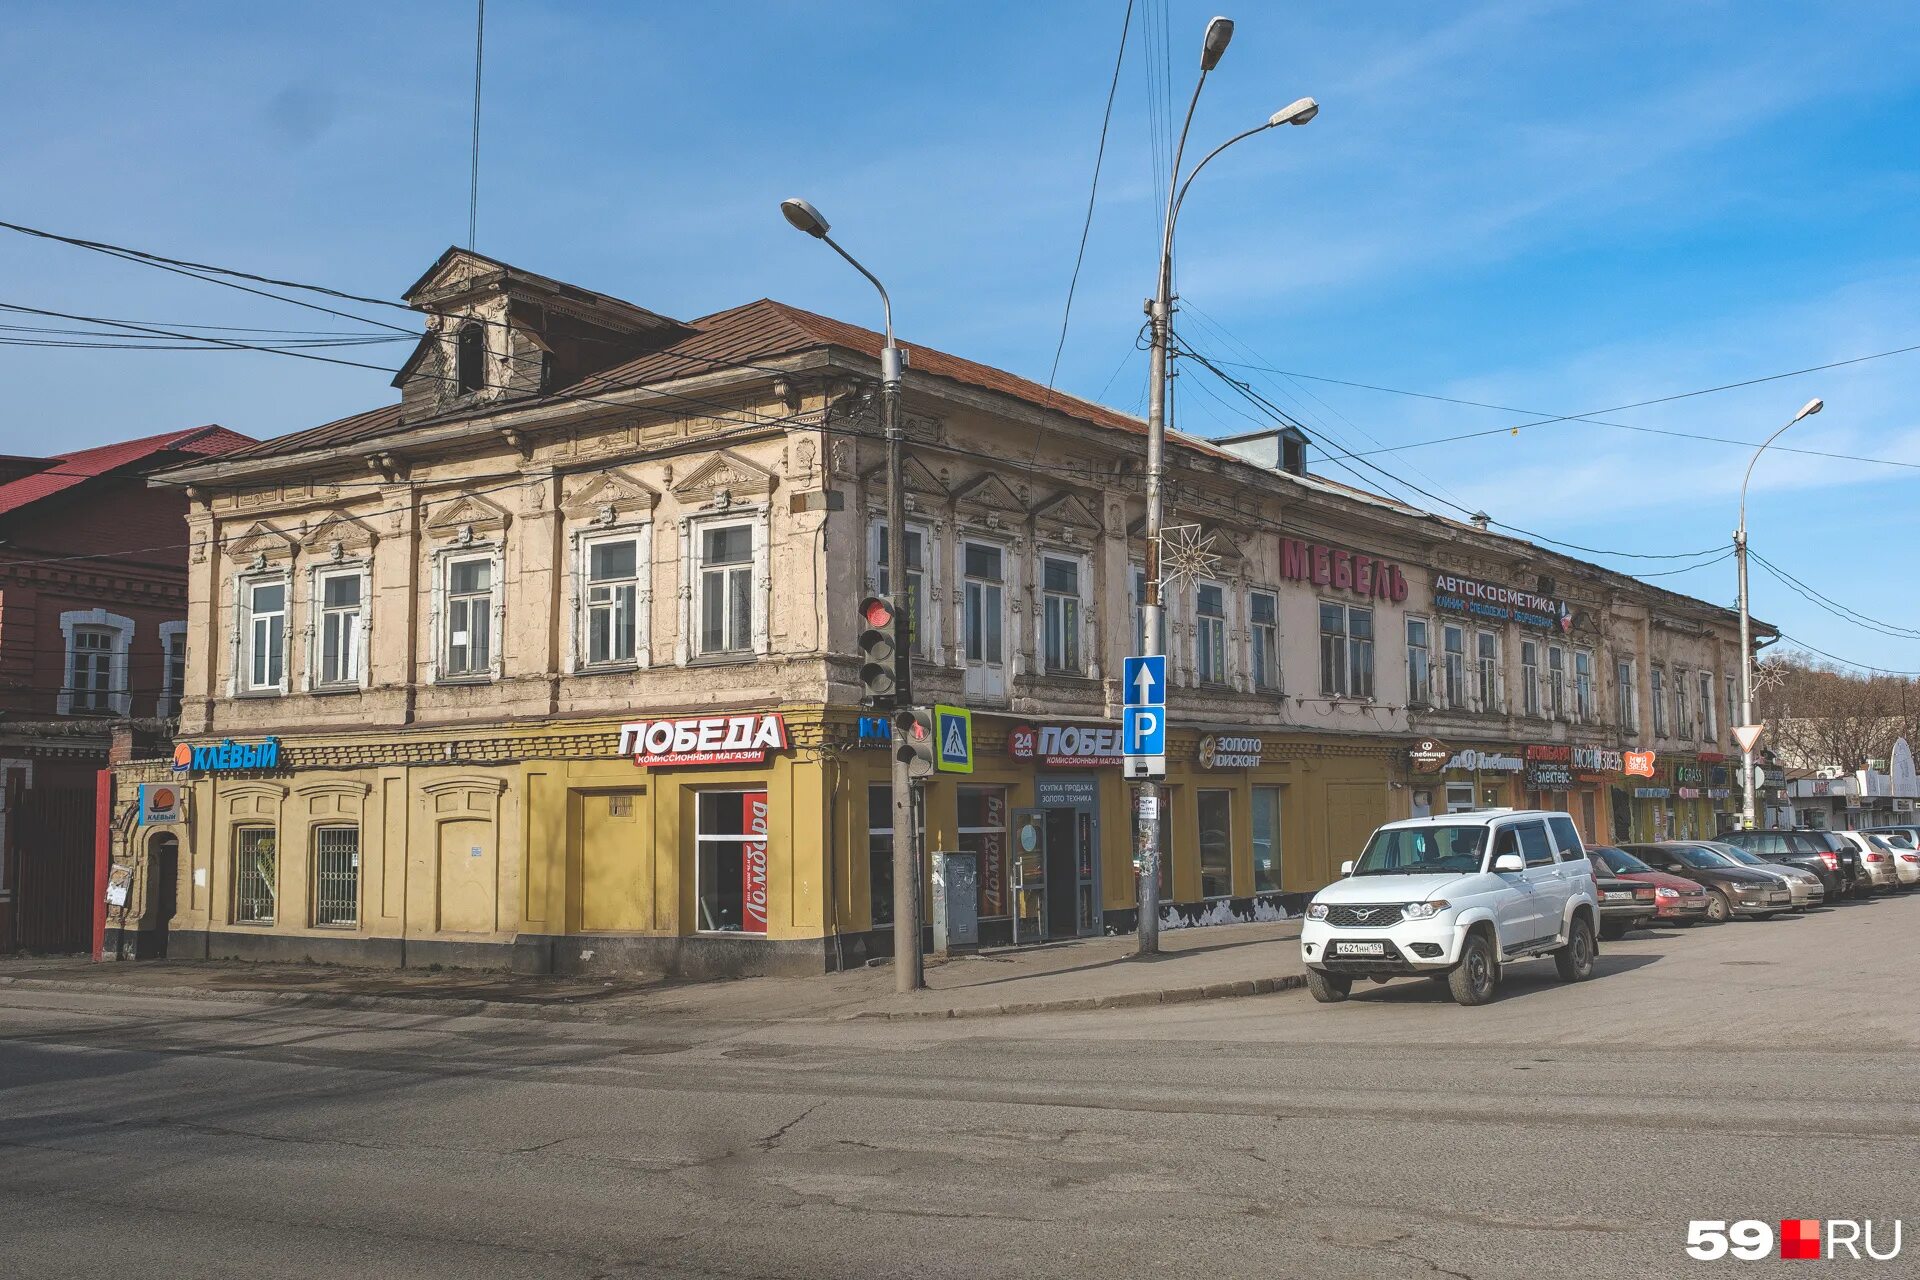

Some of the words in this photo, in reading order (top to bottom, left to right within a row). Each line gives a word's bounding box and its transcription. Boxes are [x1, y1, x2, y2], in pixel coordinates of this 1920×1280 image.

[1279, 538, 1409, 602] МЕБЕЛЬ
[1436, 575, 1556, 615] АВТОКОСМЕТИКА
[858, 716, 892, 738] КЛ
[618, 716, 781, 755] ПОБЕДА
[1014, 733, 1033, 749] 24
[1037, 726, 1123, 756] ПОБЕД
[1218, 736, 1262, 752] ЗОЛОТО
[193, 737, 279, 770] КЛЁВЫЙ
[638, 753, 713, 764] КОМИССИОННЫЙ
[715, 751, 761, 761] МАГАЗИН
[1015, 749, 1034, 757] ЧАСА
[1215, 754, 1261, 767] ДИСКОНТ
[1409, 750, 1446, 758] Хлебница
[1046, 756, 1098, 765] КОМИССИОННЫЙ
[1100, 757, 1124, 766] МАГАЗИ
[1684, 768, 1702, 782] GRASS
[1040, 784, 1063, 792] СКУПКА
[1065, 784, 1094, 793] ПРОДАЖА
[1042, 795, 1065, 803] ЗОЛОТО
[1067, 794, 1092, 802] ТЕХНИКА
